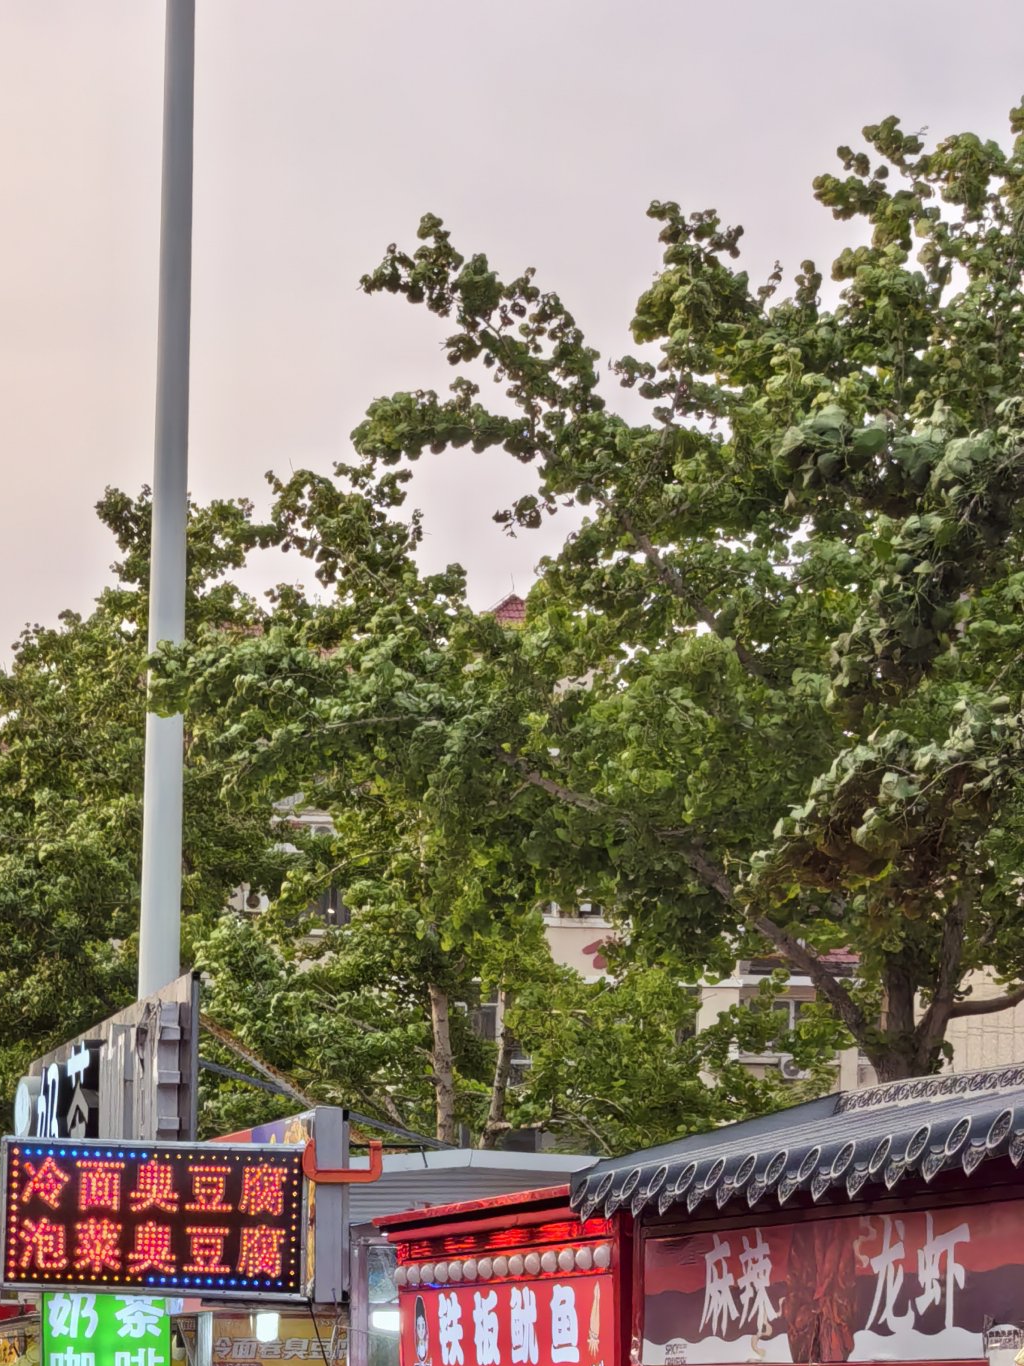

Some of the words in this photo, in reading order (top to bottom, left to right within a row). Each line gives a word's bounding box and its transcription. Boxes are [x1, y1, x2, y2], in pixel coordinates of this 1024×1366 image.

[20, 1156, 288, 1217] 冷面臭豆腐
[19, 1218, 286, 1278] 泡菜臭豆腐
[697, 1228, 781, 1339] 麻辣
[867, 1212, 971, 1333] 龙虾
[48, 1292, 165, 1338] 奶茶
[437, 1283, 580, 1366] 铁板鱿鱼
